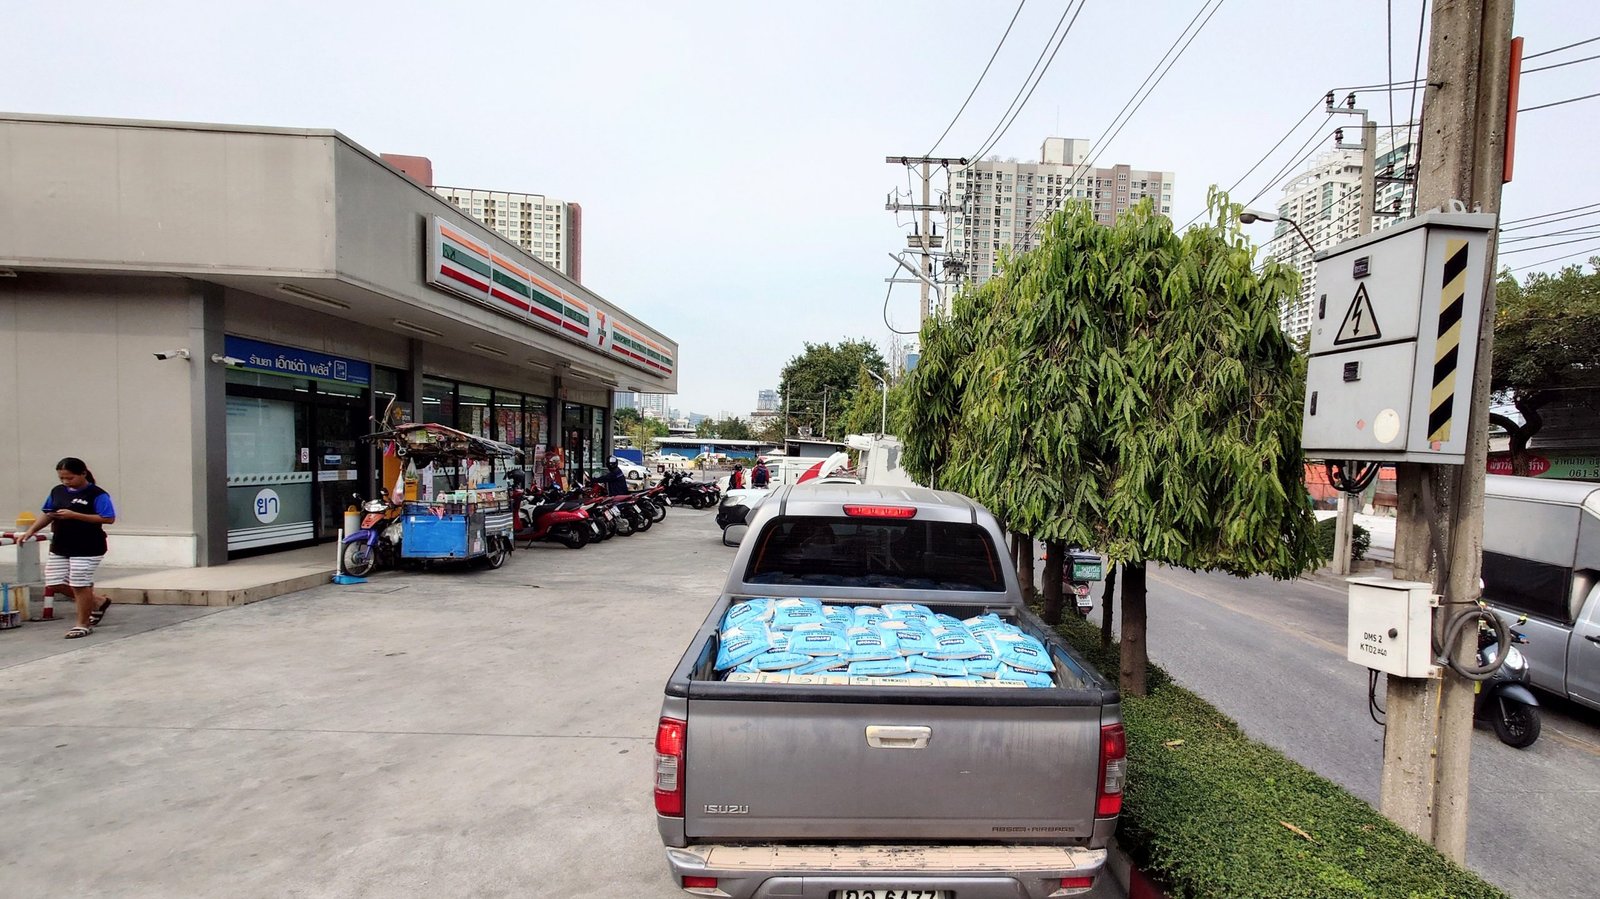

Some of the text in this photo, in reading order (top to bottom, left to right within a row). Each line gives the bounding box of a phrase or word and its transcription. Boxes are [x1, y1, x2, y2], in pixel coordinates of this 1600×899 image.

[249, 354, 272, 367] ร้านยา
[256, 497, 278, 515] ยา
[1378, 635, 1383, 644] 2
[704, 804, 749, 814] ISUZU
